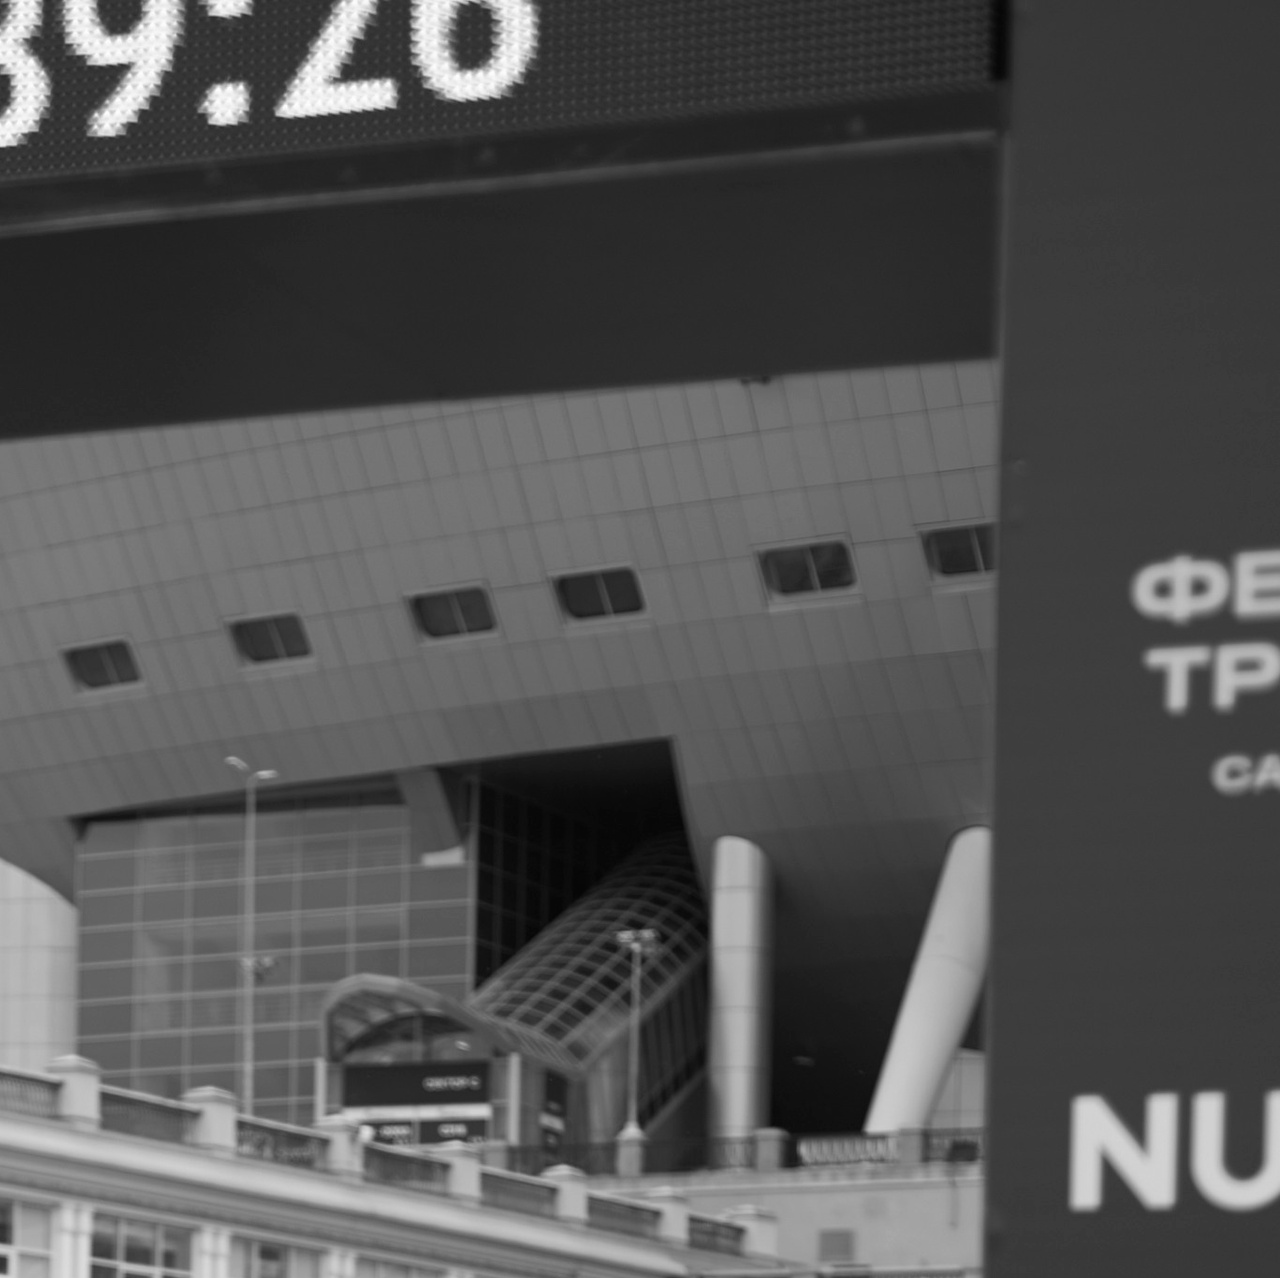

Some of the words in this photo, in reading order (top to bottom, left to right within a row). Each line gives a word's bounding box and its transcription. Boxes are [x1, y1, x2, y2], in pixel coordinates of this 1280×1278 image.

[1131, 549, 1280, 625] ФЕ
[1143, 641, 1280, 715] ТР
[1068, 1090, 1280, 1212] NU
